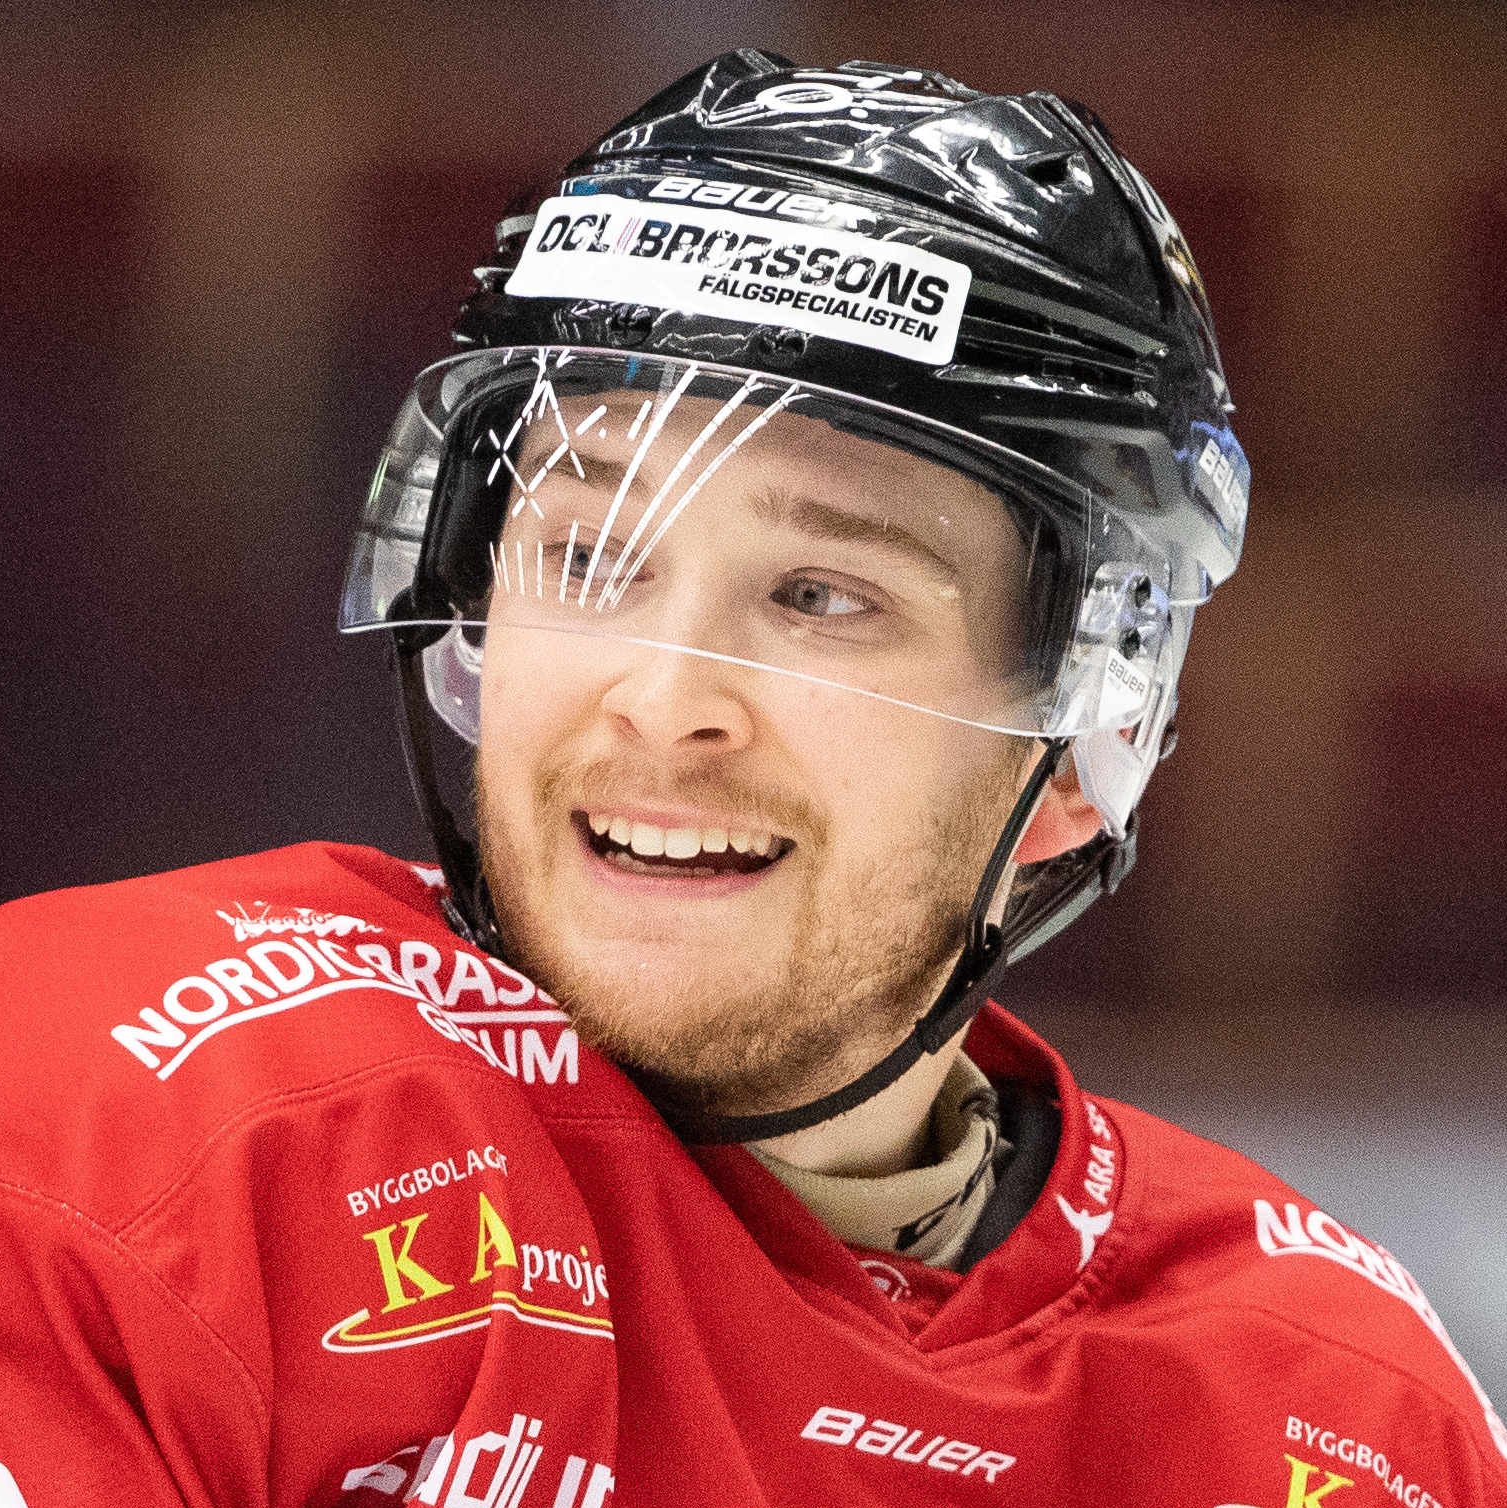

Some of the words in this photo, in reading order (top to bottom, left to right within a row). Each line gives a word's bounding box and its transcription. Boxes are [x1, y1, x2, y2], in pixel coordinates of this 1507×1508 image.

[697, 273, 939, 343] FÄLGSPECIALISTEN
[1108, 658, 1146, 696] BAUER
[800, 1405, 1018, 1483] BAUER
